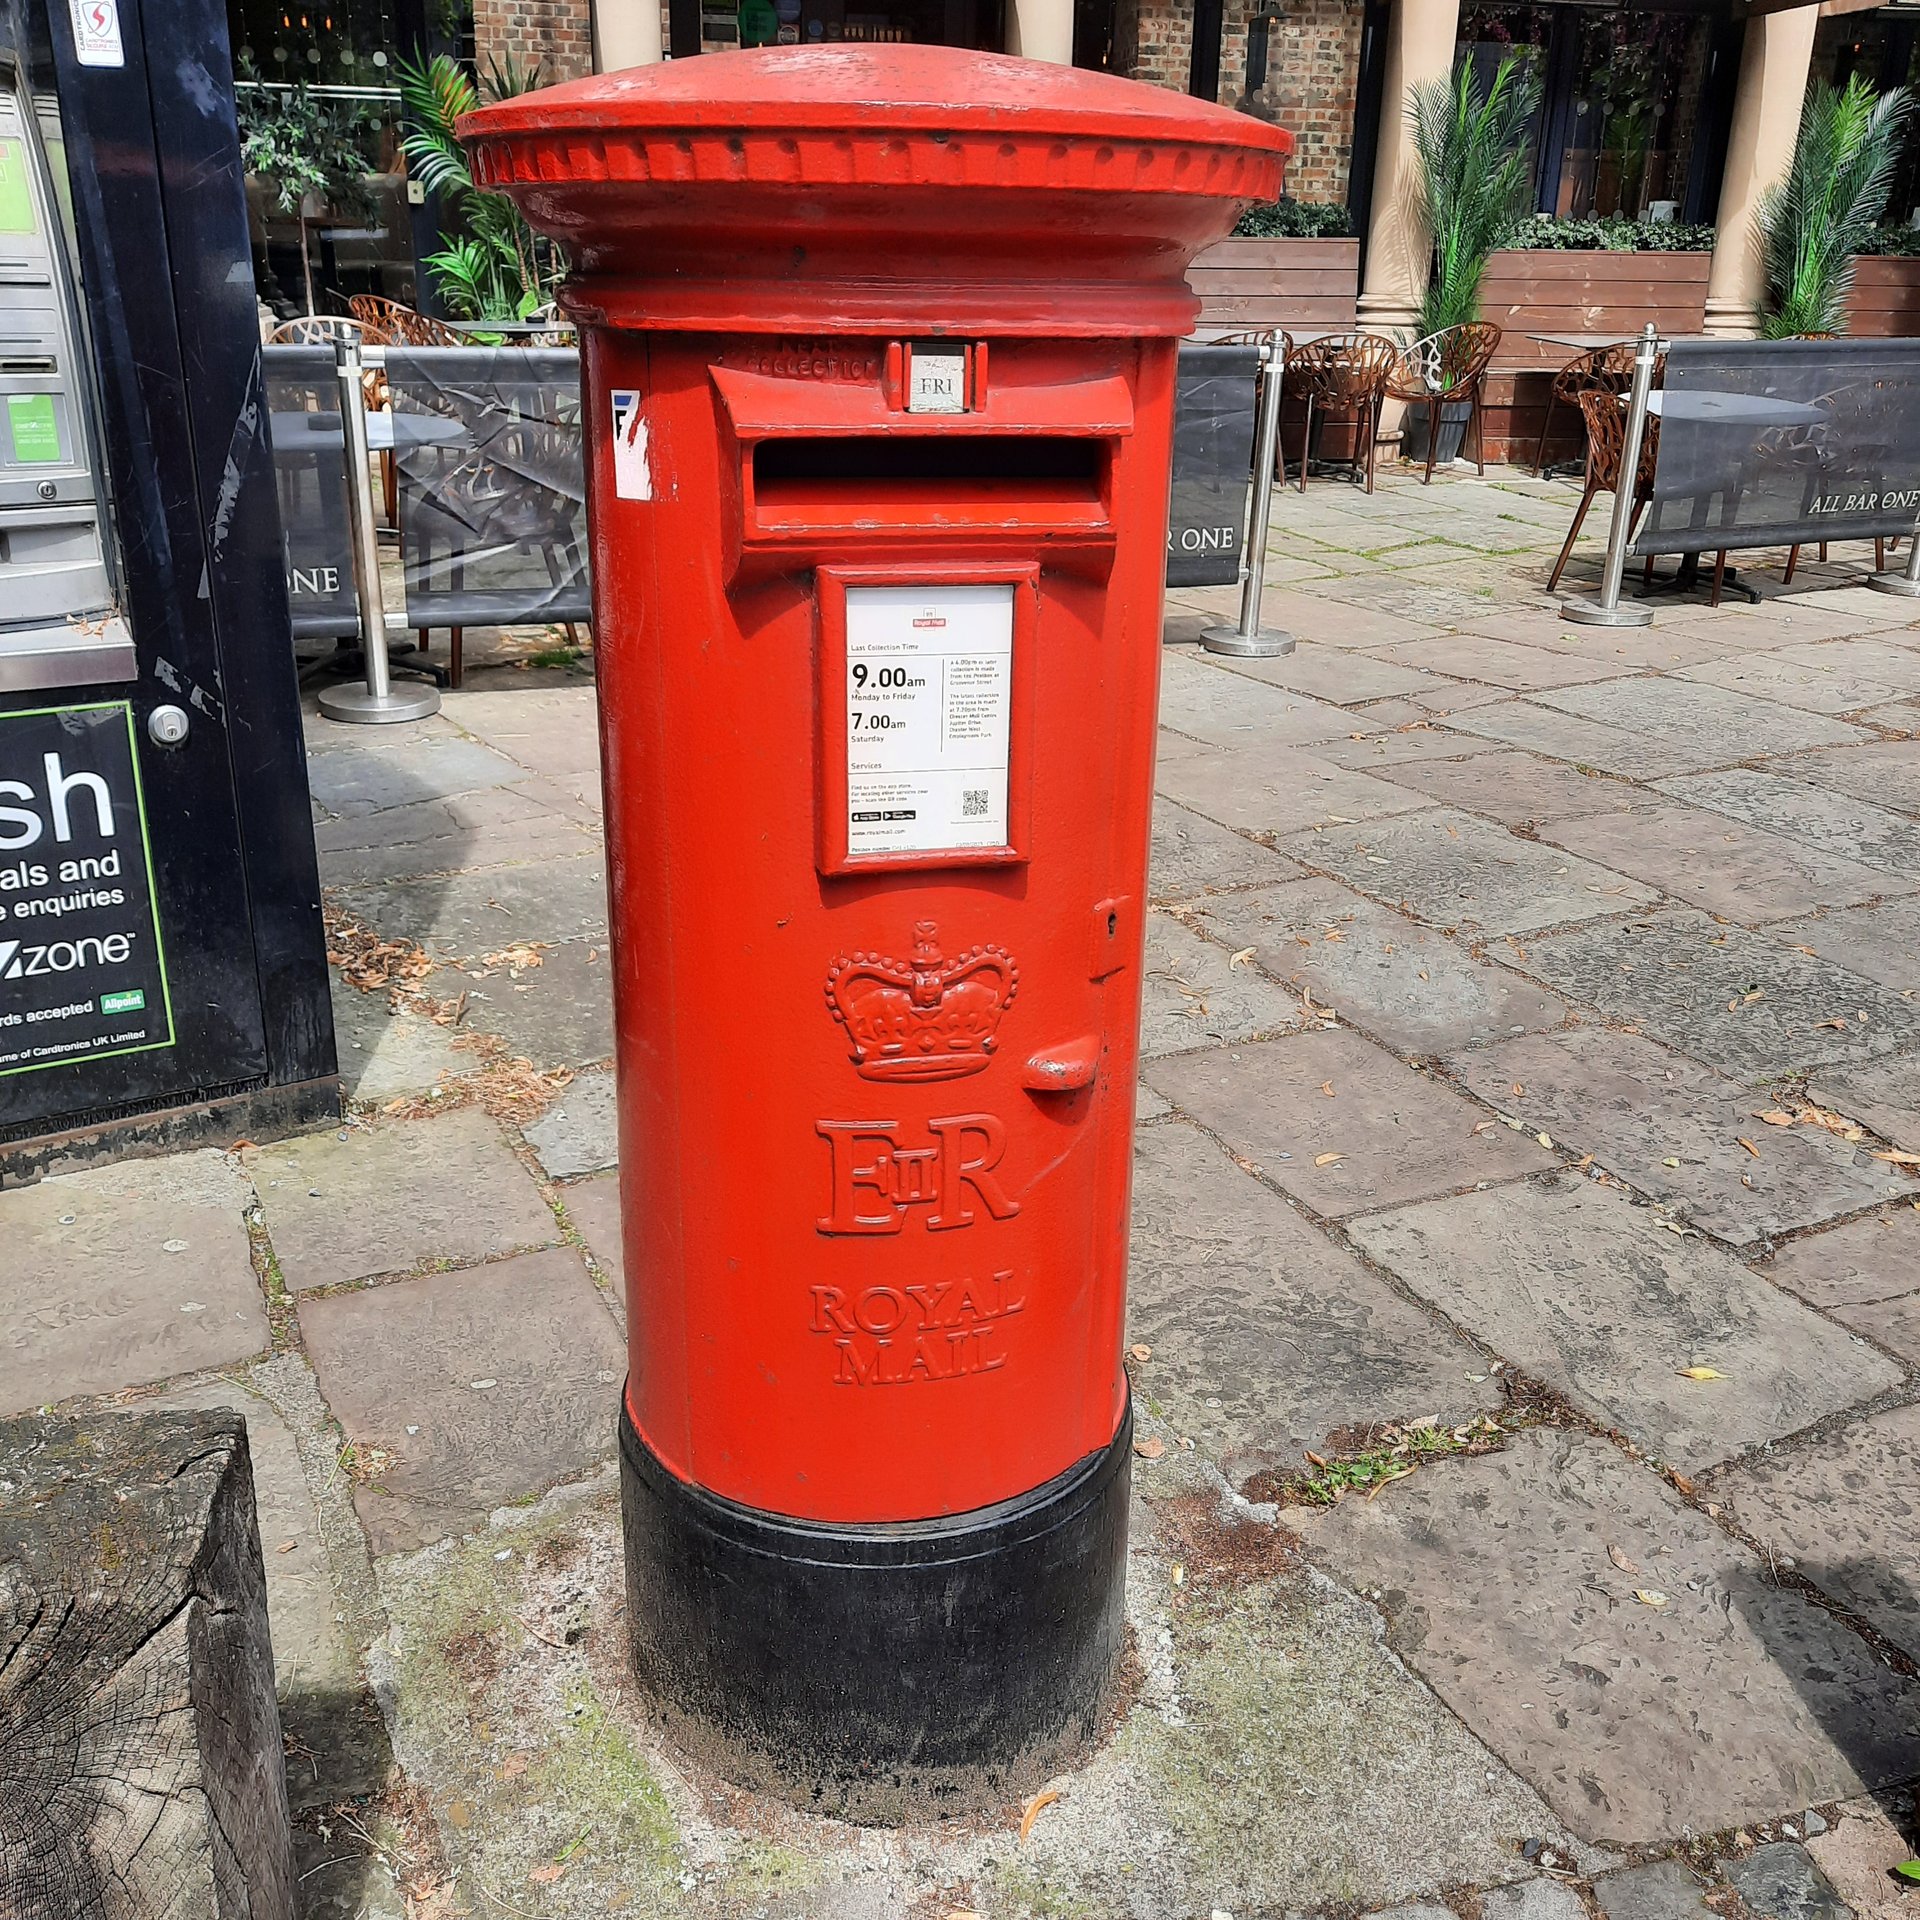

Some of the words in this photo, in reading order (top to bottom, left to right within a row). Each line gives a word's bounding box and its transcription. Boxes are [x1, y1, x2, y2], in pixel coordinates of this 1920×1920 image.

[920, 377, 953, 395] FRI
[1808, 495, 1841, 514] ALL
[1842, 493, 1878, 512] BAR
[1881, 489, 1920, 509] ONE
[1181, 527, 1234, 550] ONE
[287, 567, 340, 594] NE
[852, 663, 926, 688] 9.00am
[851, 693, 880, 701] Monday
[892, 693, 916, 701] Friday
[851, 712, 906, 730] 7.00am
[851, 735, 884, 743] Saturday
[851, 762, 882, 770] Services
[0, 752, 116, 850] sh
[0, 861, 49, 891] als
[59, 849, 121, 882] and
[13, 888, 125, 918] enquiries
[26, 1000, 94, 1022] accepted
[104, 993, 142, 1010] Allpoint
[0, 1052, 18, 1063] me
[20, 1049, 31, 1059] of
[33, 1040, 91, 1057] Cardtronics
[92, 1035, 109, 1046] UK
[111, 1029, 146, 1043] Limited
[808, 1269, 1026, 1334] ROYAL
[833, 1325, 1008, 1386] MAIL
